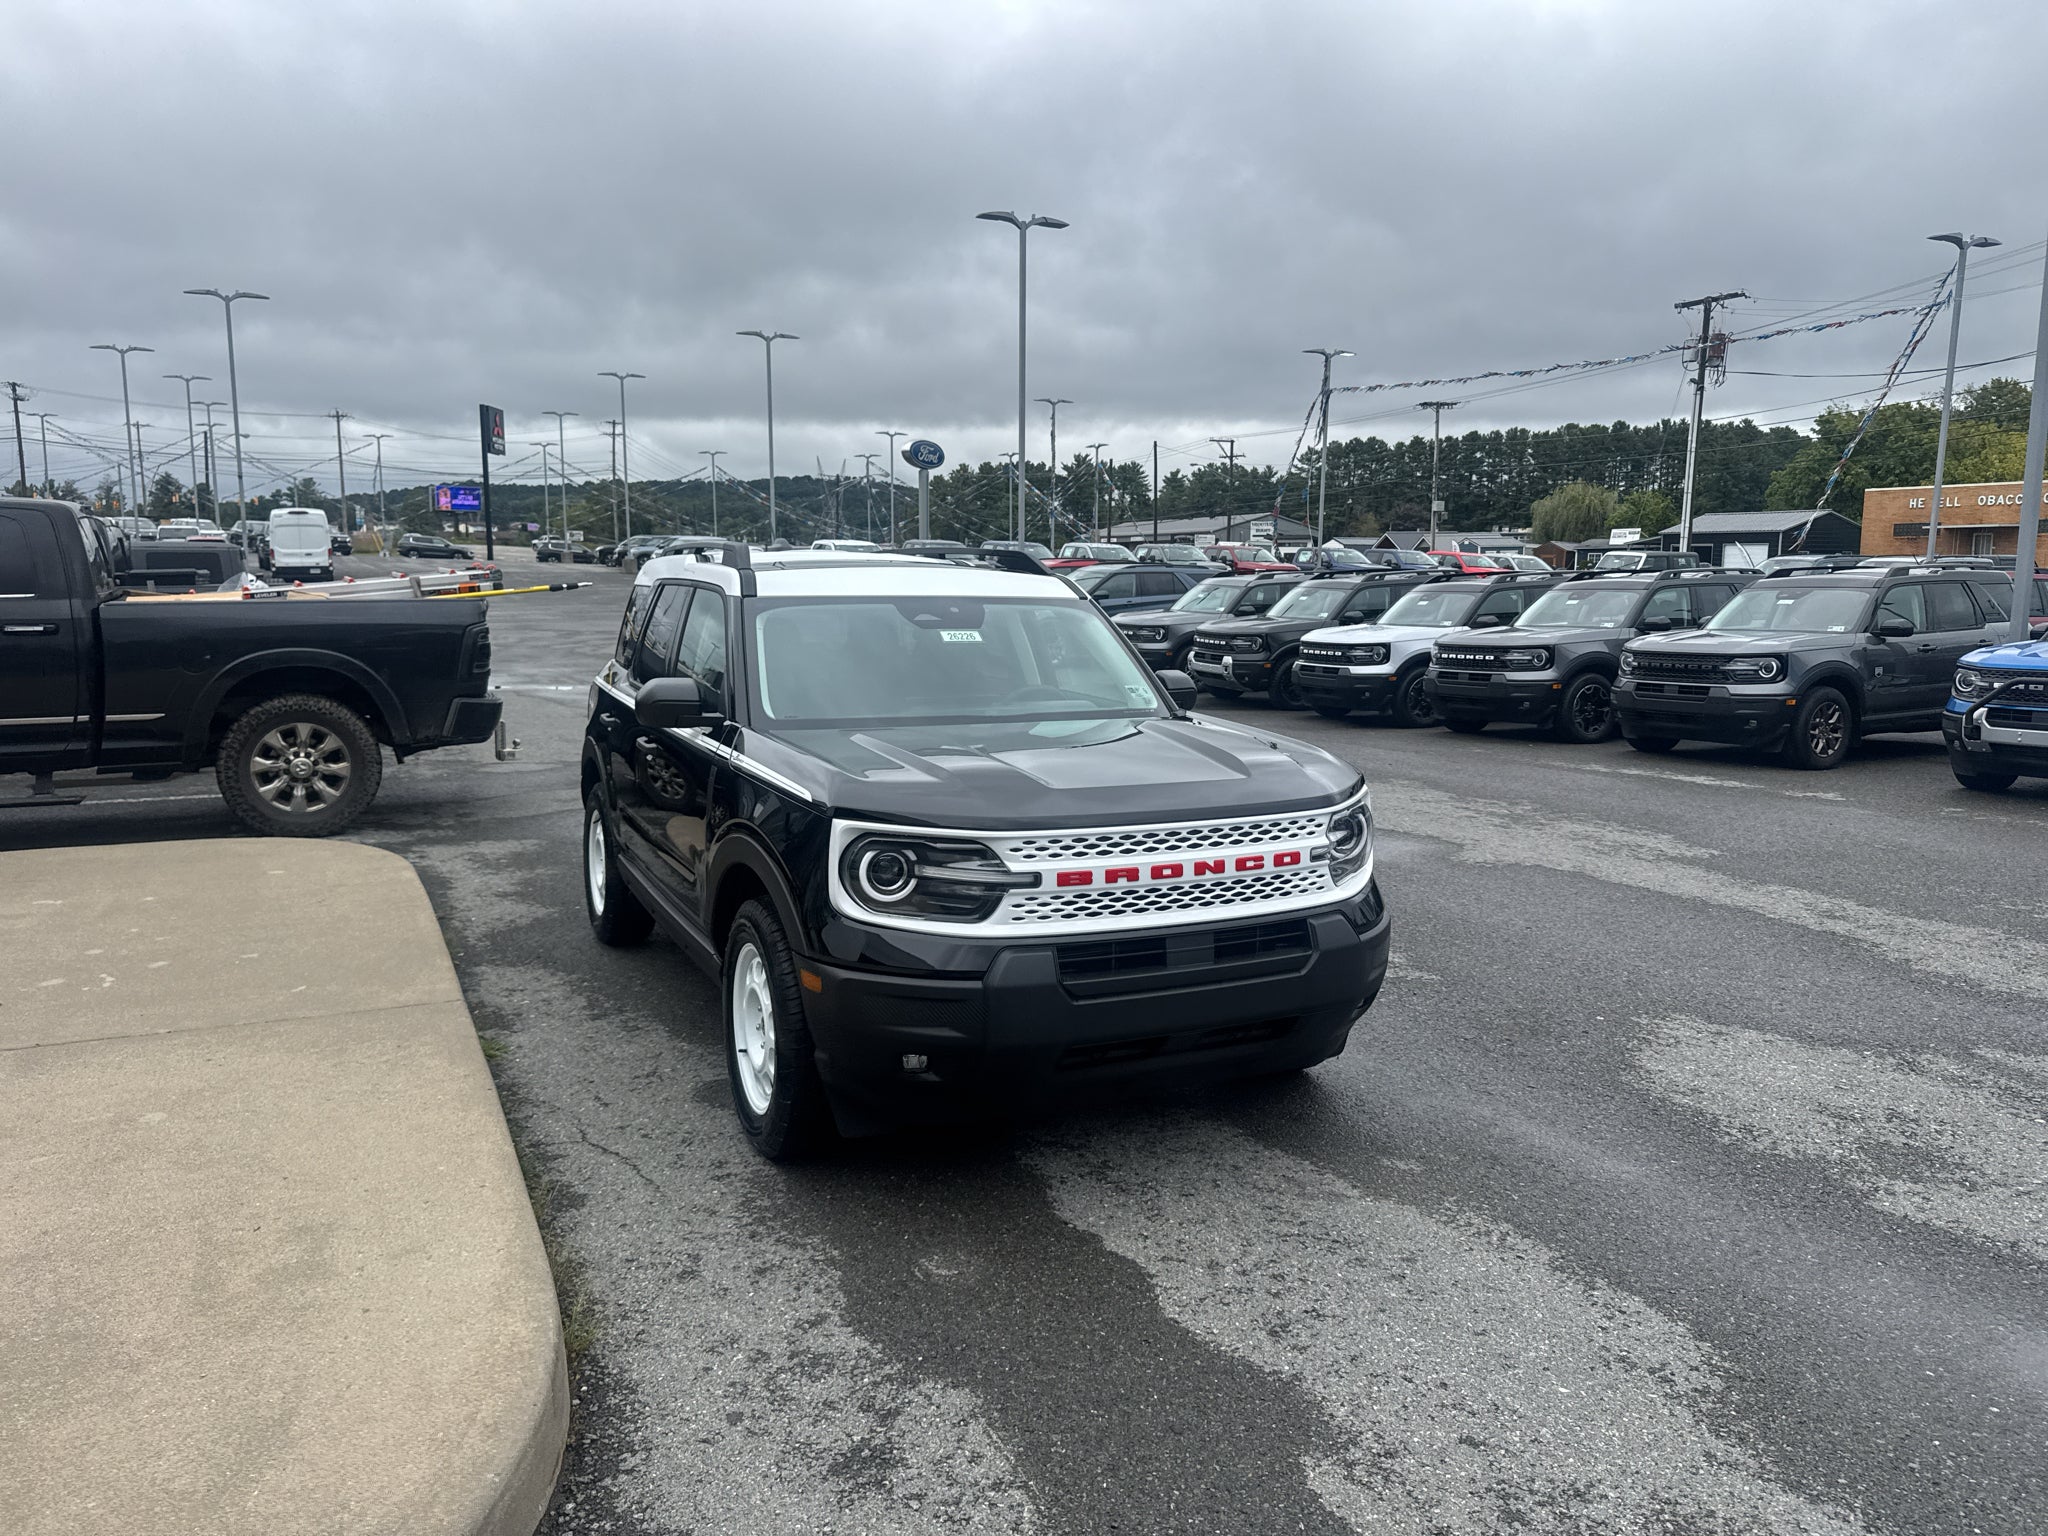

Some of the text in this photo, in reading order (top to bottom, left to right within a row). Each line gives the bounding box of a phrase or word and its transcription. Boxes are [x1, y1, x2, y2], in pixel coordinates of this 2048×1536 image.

[917, 444, 940, 464] Ford
[1977, 494, 2024, 506] OBACC
[253, 591, 278, 600] LEVELER
[947, 632, 976, 641] 26226
[1441, 653, 1495, 661] BRONCO
[1640, 661, 1713, 670] BRONCO
[1056, 850, 1301, 888] BRONCO
